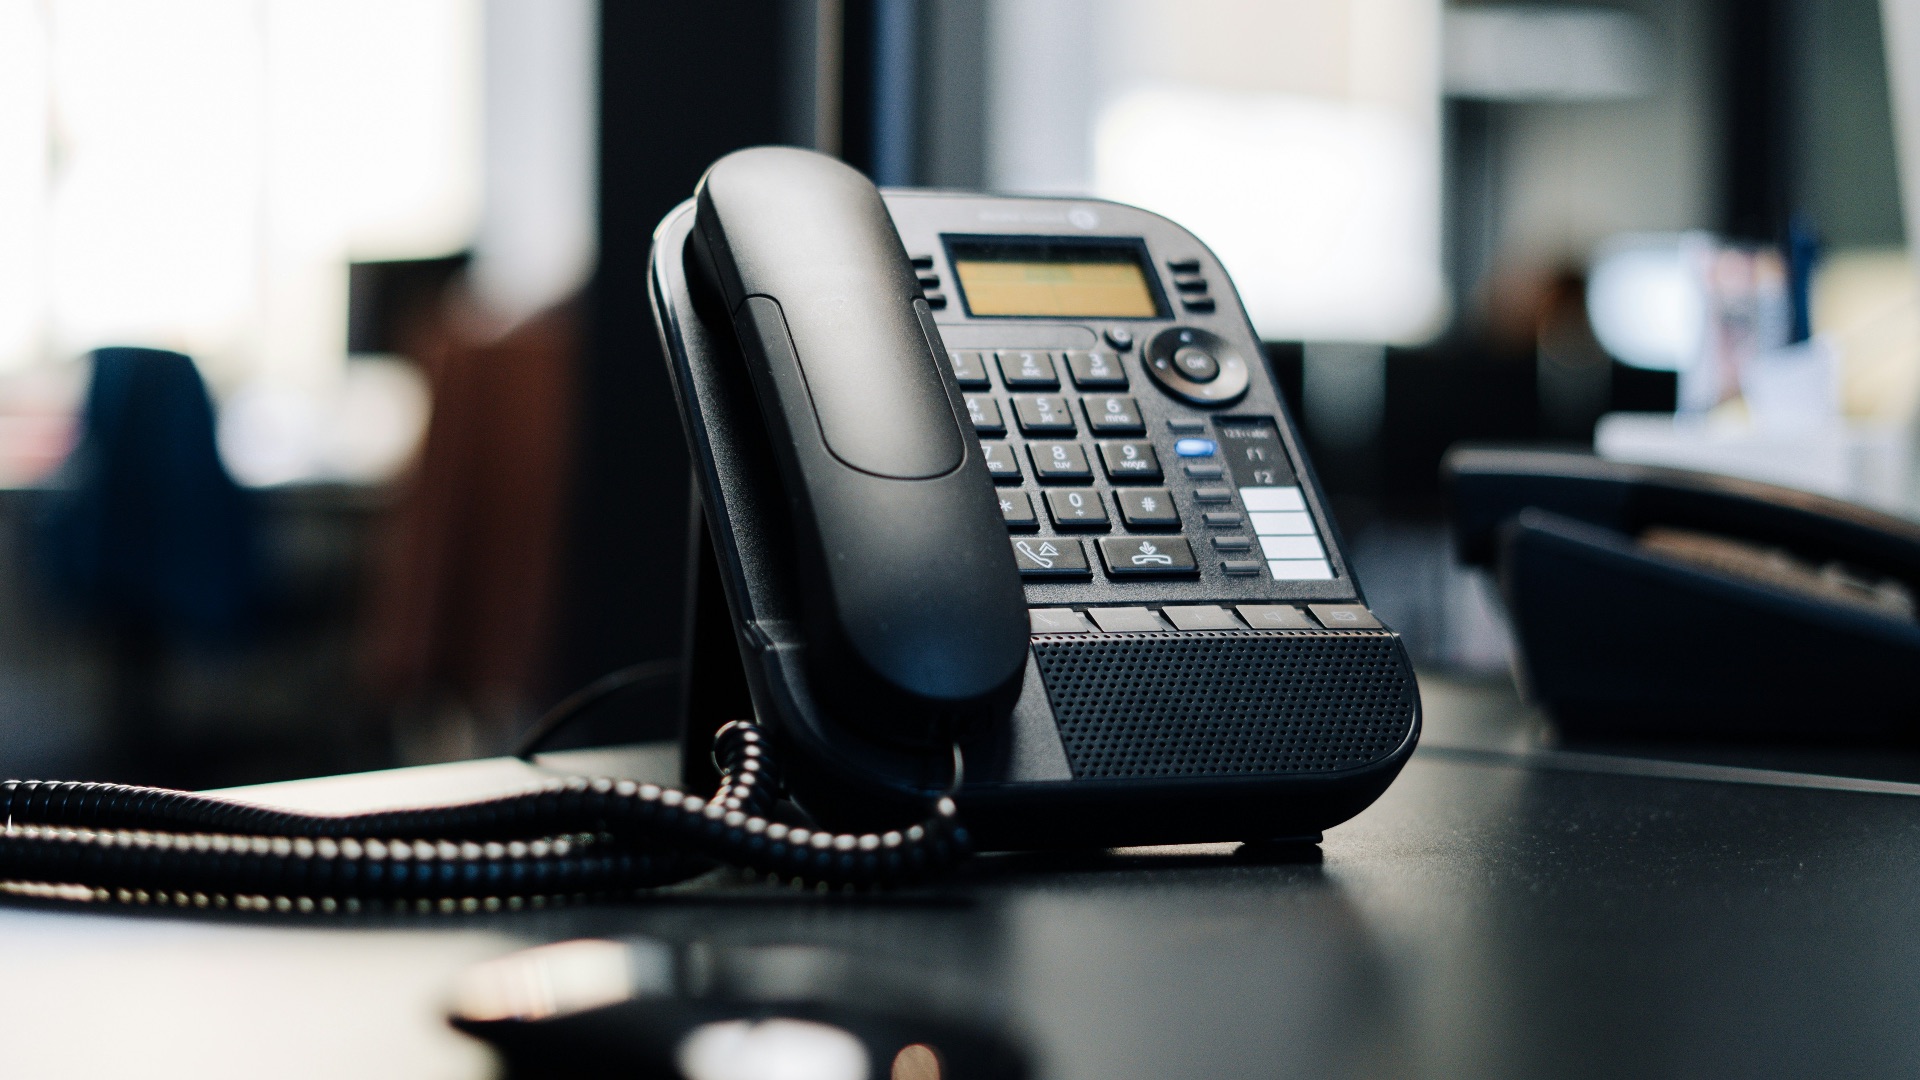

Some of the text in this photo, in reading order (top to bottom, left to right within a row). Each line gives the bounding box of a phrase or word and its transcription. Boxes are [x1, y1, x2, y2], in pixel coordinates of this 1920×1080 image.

[1020, 353, 1035, 367] 2
[1089, 352, 1103, 367] 3
[1186, 358, 1206, 369] OK
[1022, 368, 1041, 377] abc
[1091, 367, 1109, 377] def
[967, 398, 978, 411] 4
[1036, 398, 1050, 412] 5
[1106, 398, 1121, 413] 6
[1105, 414, 1128, 422] mno
[982, 445, 992, 460] 7
[1052, 446, 1066, 460] 8
[1122, 446, 1137, 460] 9
[1246, 448, 1264, 461] F1
[1054, 460, 1071, 469] tuv
[1120, 460, 1148, 470] wxyz
[1254, 471, 1273, 484] F2
[1069, 493, 1082, 507] 0
[1141, 496, 1155, 512] #
